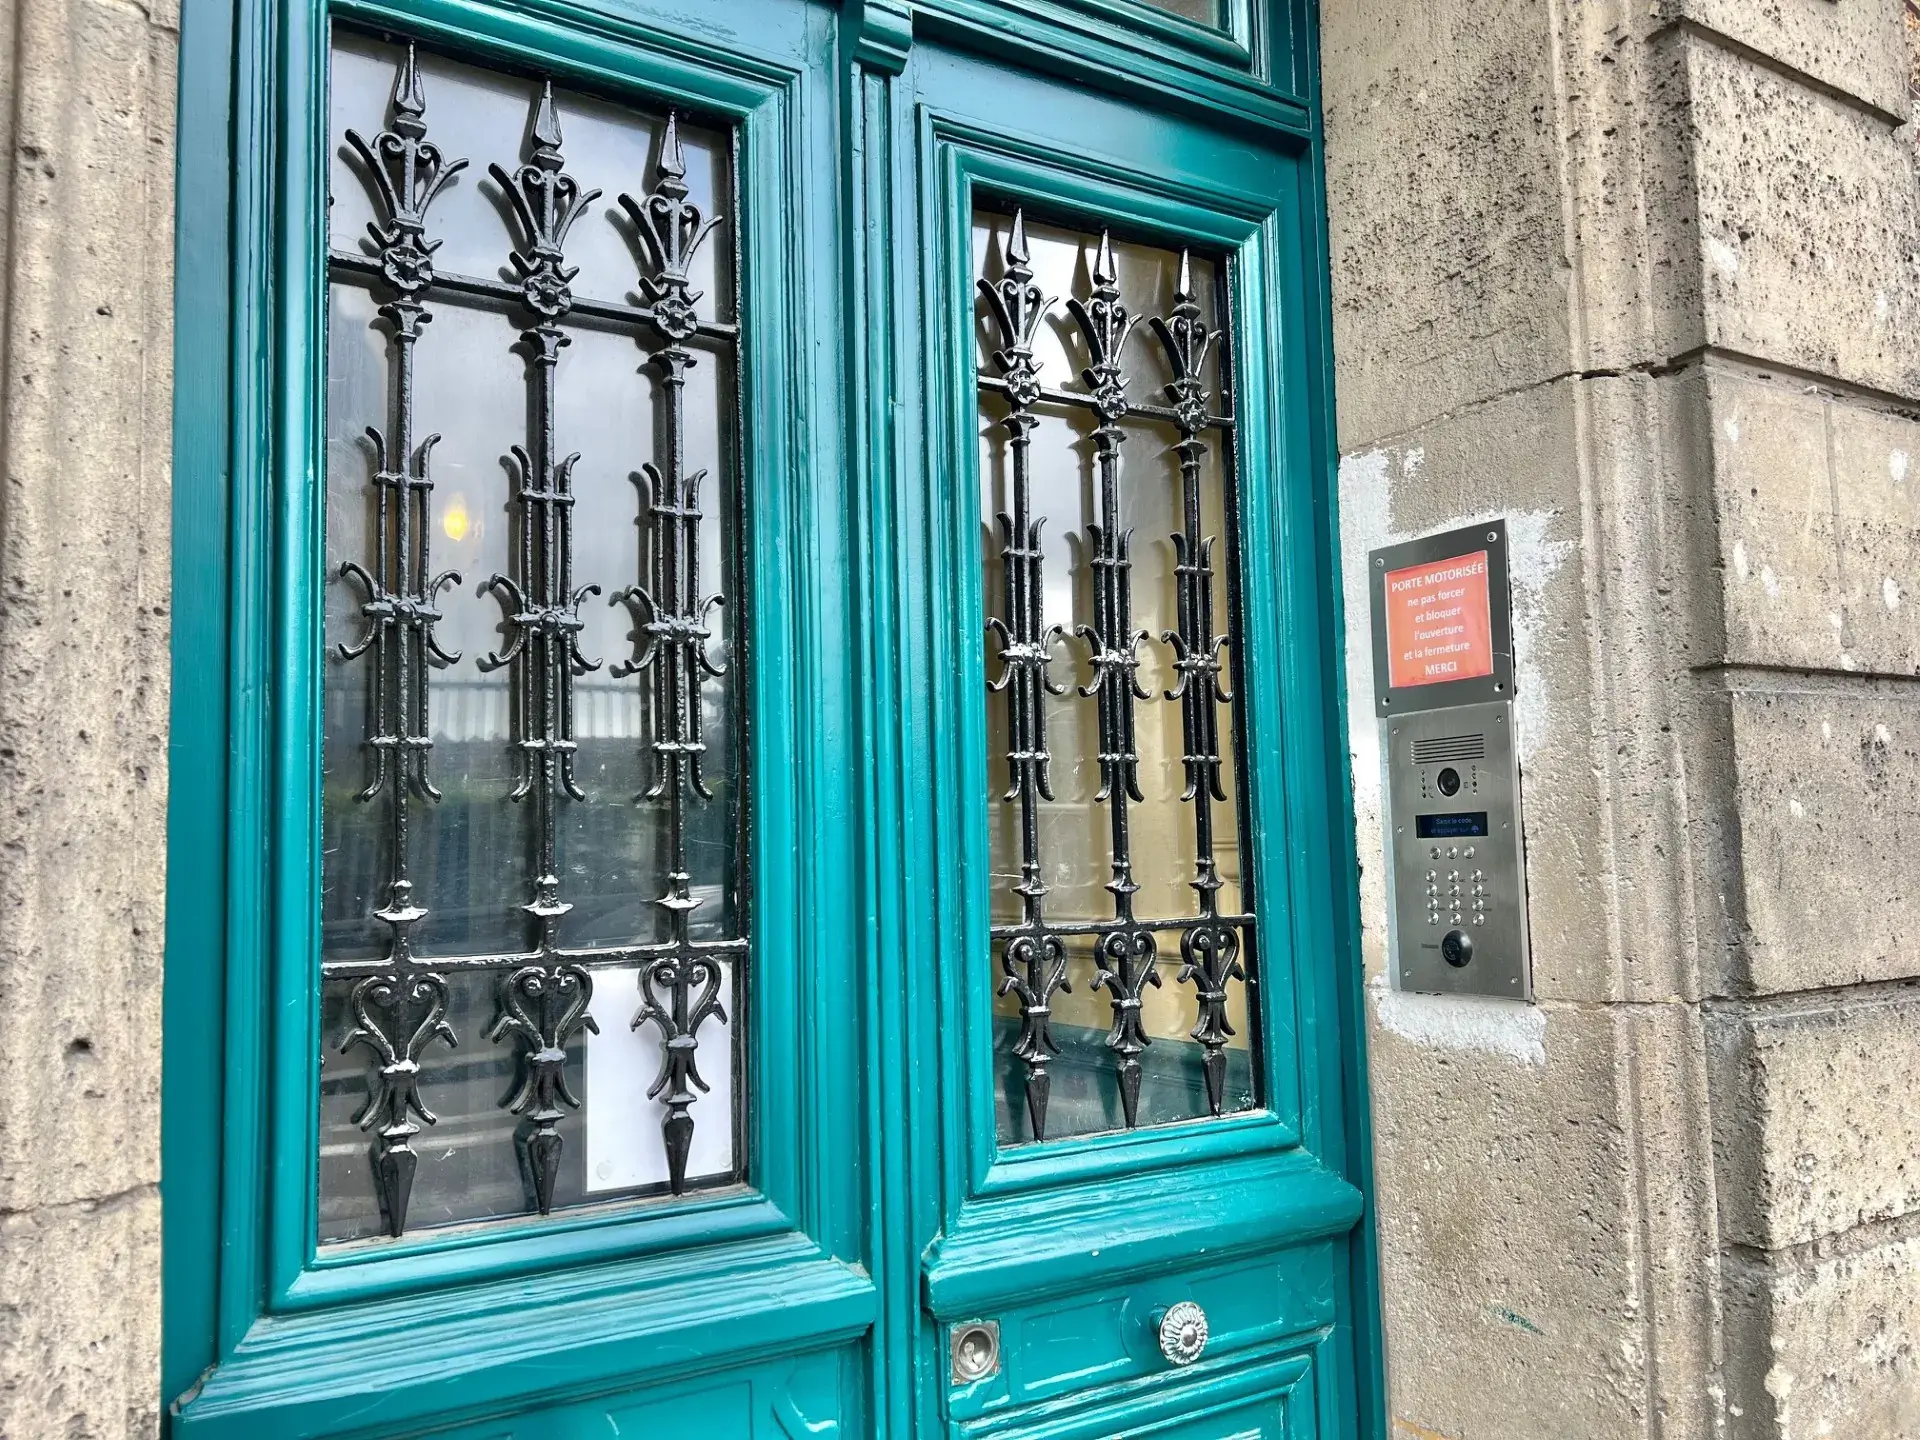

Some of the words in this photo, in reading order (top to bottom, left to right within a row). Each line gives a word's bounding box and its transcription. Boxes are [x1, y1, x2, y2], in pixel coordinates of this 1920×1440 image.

[1391, 577, 1422, 592] PORTE
[1425, 562, 1484, 585] MOTORISÉE
[1407, 598, 1418, 607] ne
[1421, 594, 1436, 607] pas
[1438, 587, 1465, 600] forcer
[1415, 613, 1424, 623] et
[1426, 607, 1461, 621] bloquer
[1414, 624, 1464, 640] l'ouverture
[1404, 651, 1412, 660] et
[1414, 648, 1422, 659] la
[1424, 642, 1470, 656] fermeture
[1425, 661, 1457, 675] MERCI
